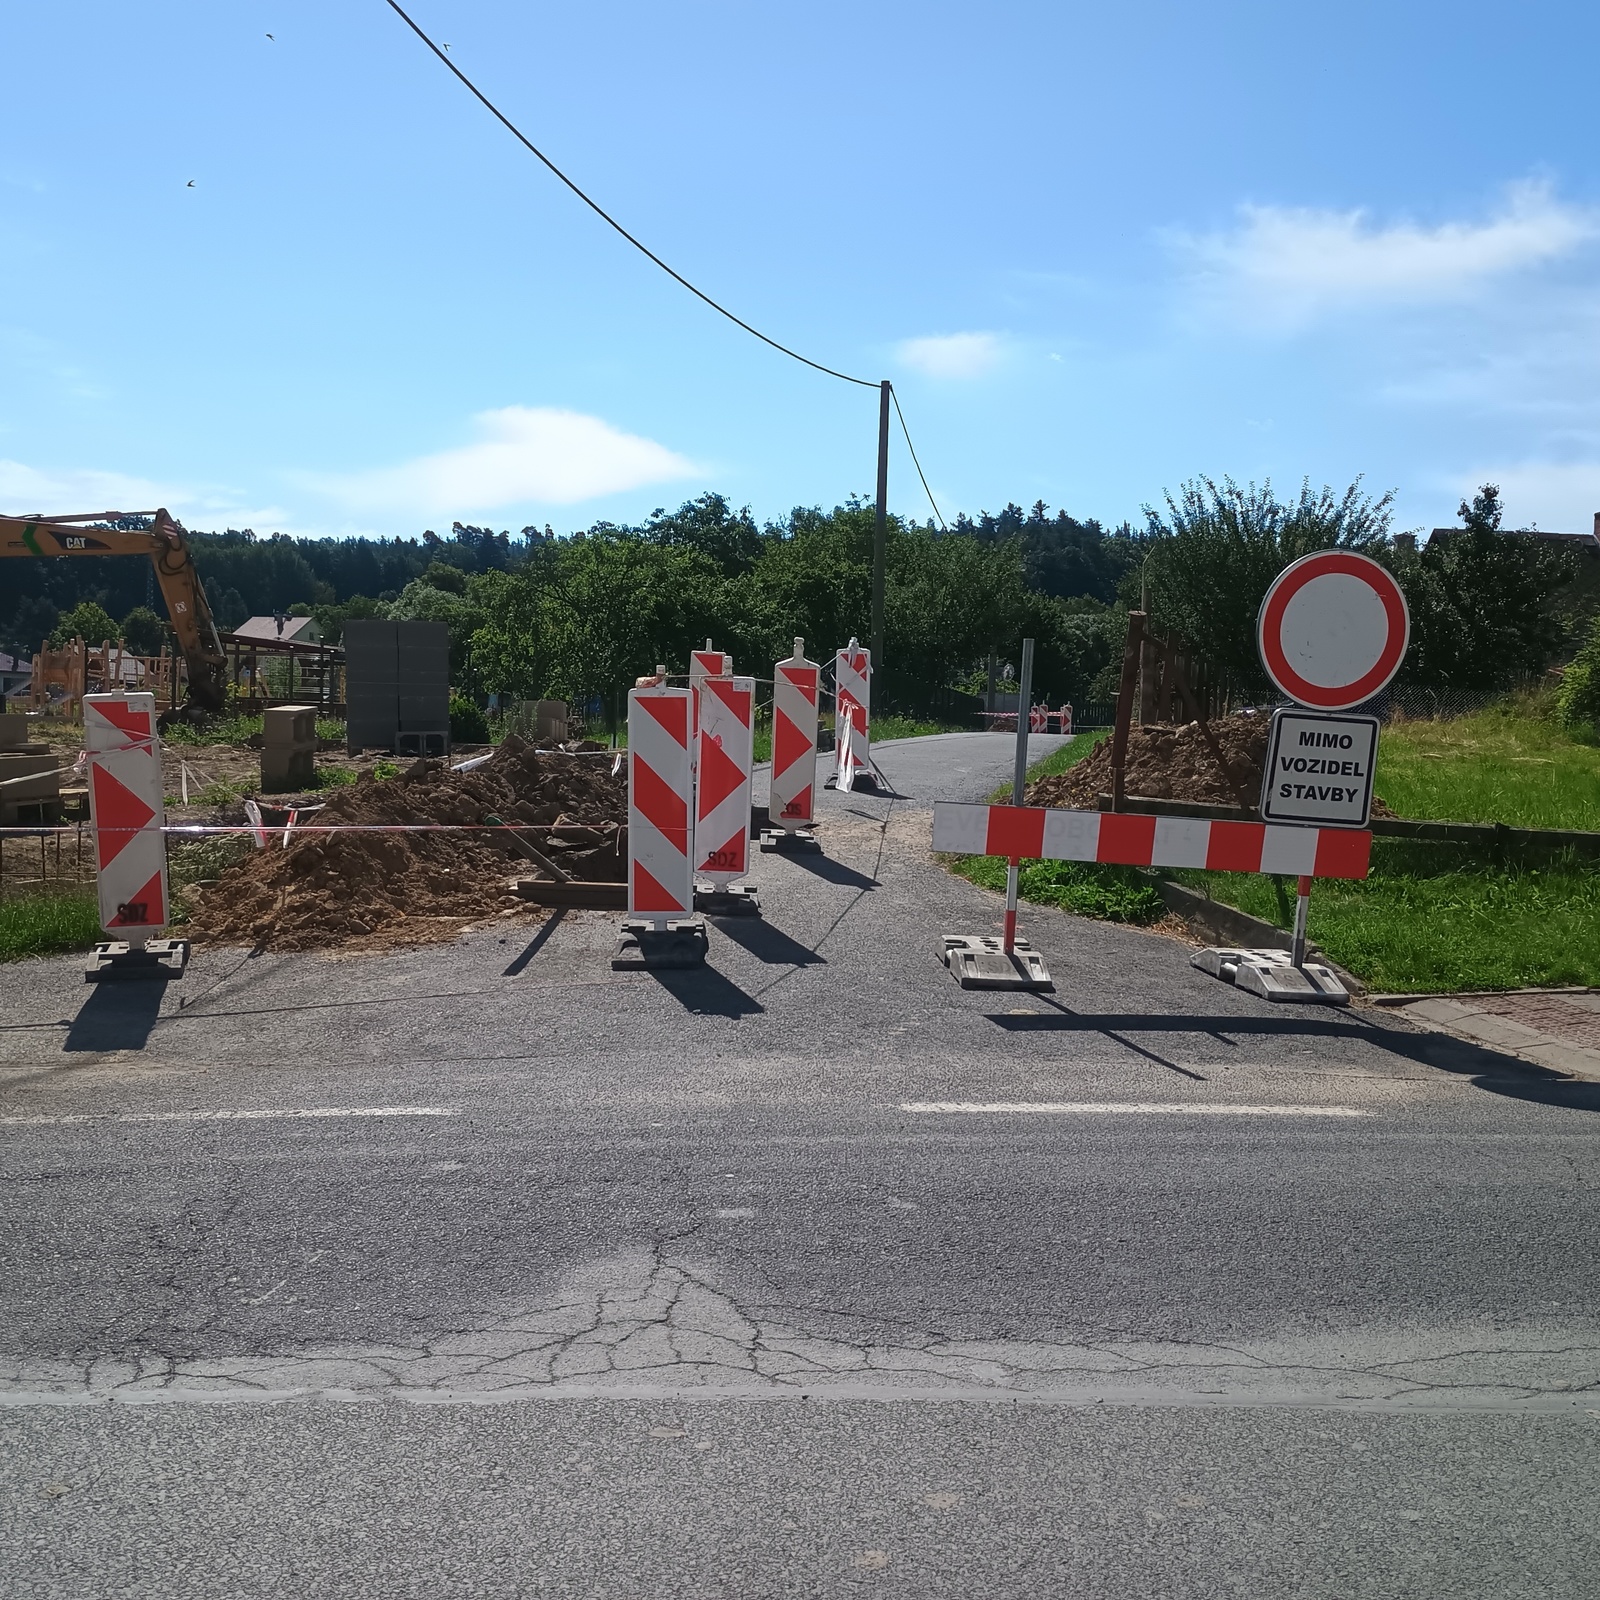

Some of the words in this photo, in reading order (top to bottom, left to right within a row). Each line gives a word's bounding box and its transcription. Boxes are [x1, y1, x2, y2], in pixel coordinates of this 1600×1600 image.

[66, 537, 86, 549] CAT
[1299, 731, 1353, 750] MIMO
[1280, 756, 1365, 777] VOZIDEL
[1279, 783, 1359, 803] STAVBY
[708, 851, 737, 868] SDZ
[117, 903, 149, 924] SDZ
